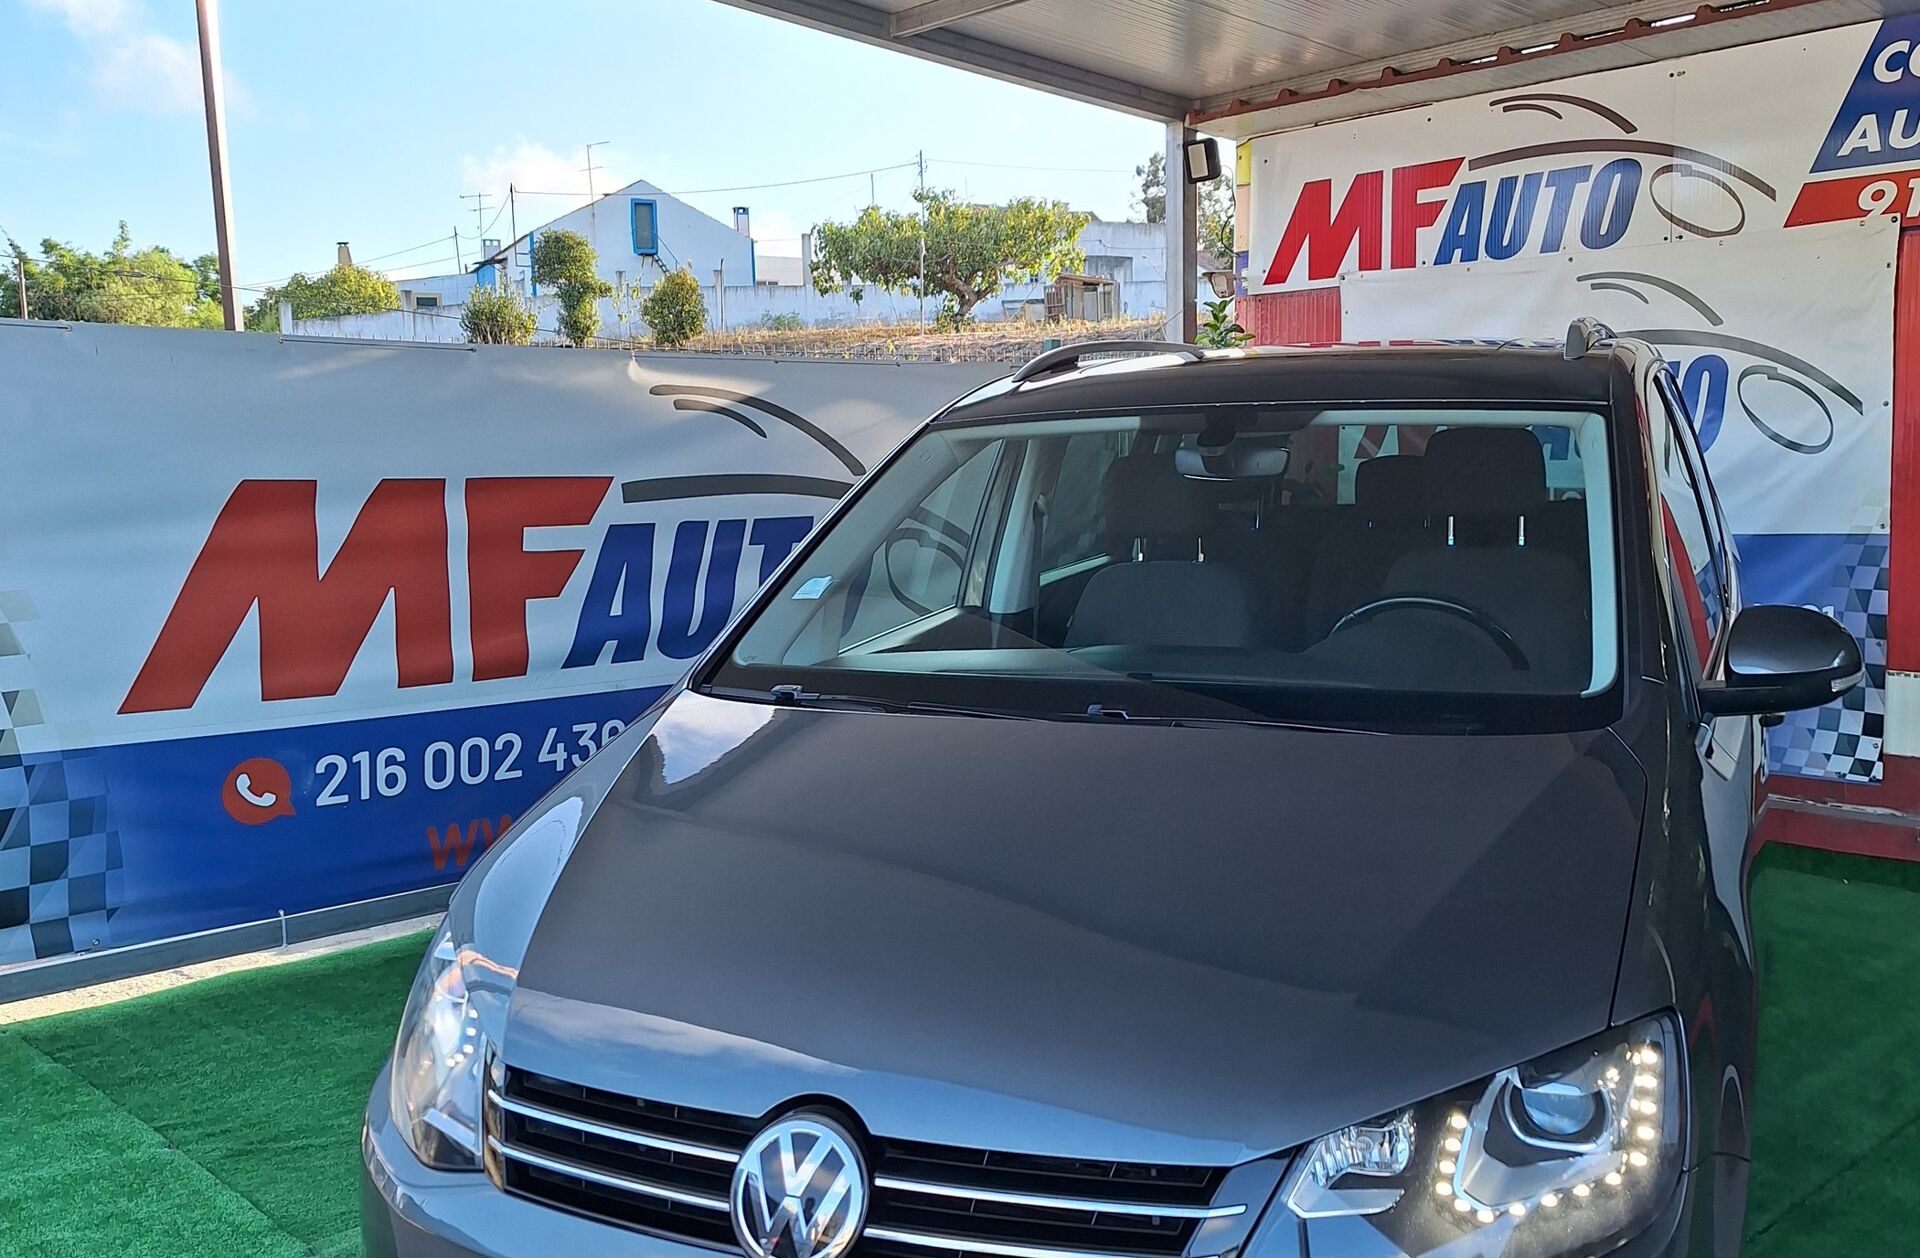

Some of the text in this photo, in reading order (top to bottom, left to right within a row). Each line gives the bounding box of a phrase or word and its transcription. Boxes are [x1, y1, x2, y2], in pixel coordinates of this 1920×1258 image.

[1873, 40, 1920, 83] C
[315, 747, 407, 807] 216
[424, 732, 523, 791] 002
